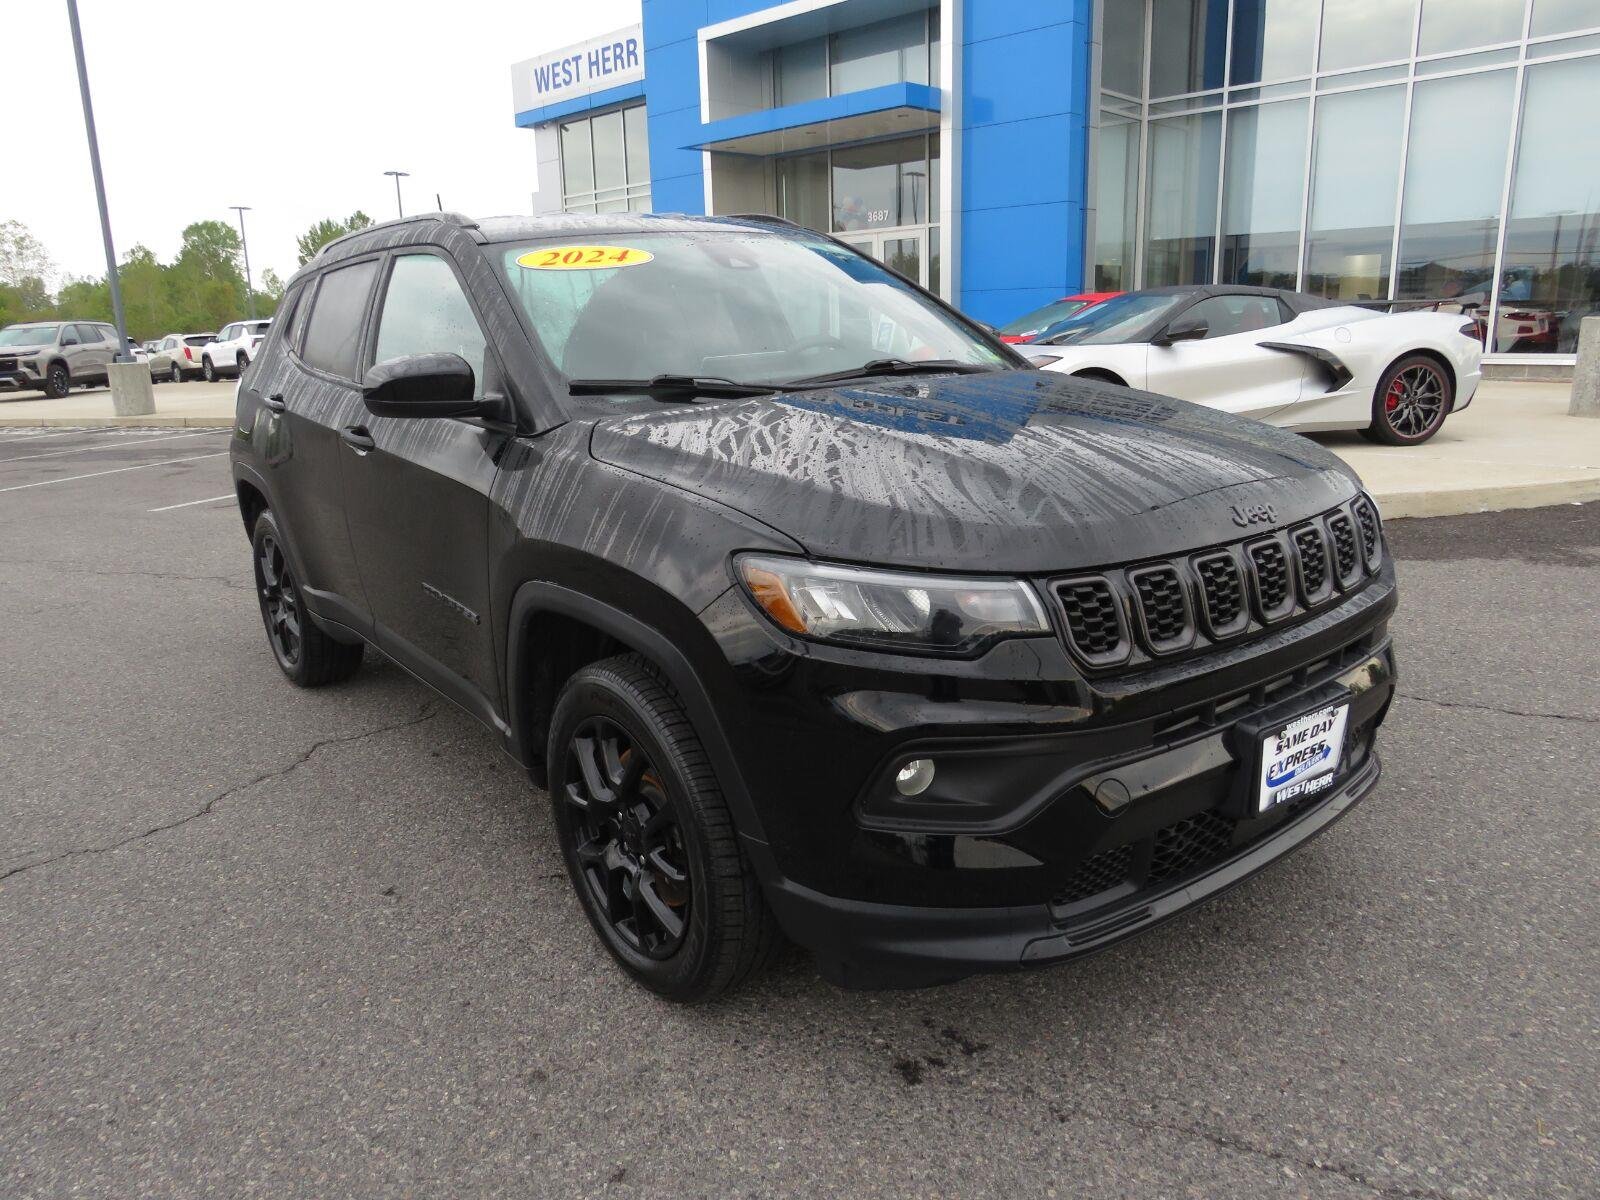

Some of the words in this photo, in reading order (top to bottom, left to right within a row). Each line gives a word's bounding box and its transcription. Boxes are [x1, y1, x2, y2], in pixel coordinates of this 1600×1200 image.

[534, 55, 582, 93] WEST
[587, 38, 639, 79] HERR
[867, 209, 889, 222] 3687
[539, 249, 630, 266] 2024
[1228, 504, 1278, 528] Jeep
[1286, 705, 1334, 731] westherr.com
[1275, 728, 1310, 756] SAME
[1310, 717, 1337, 739] DAY
[1268, 739, 1326, 780] EXPRESS
